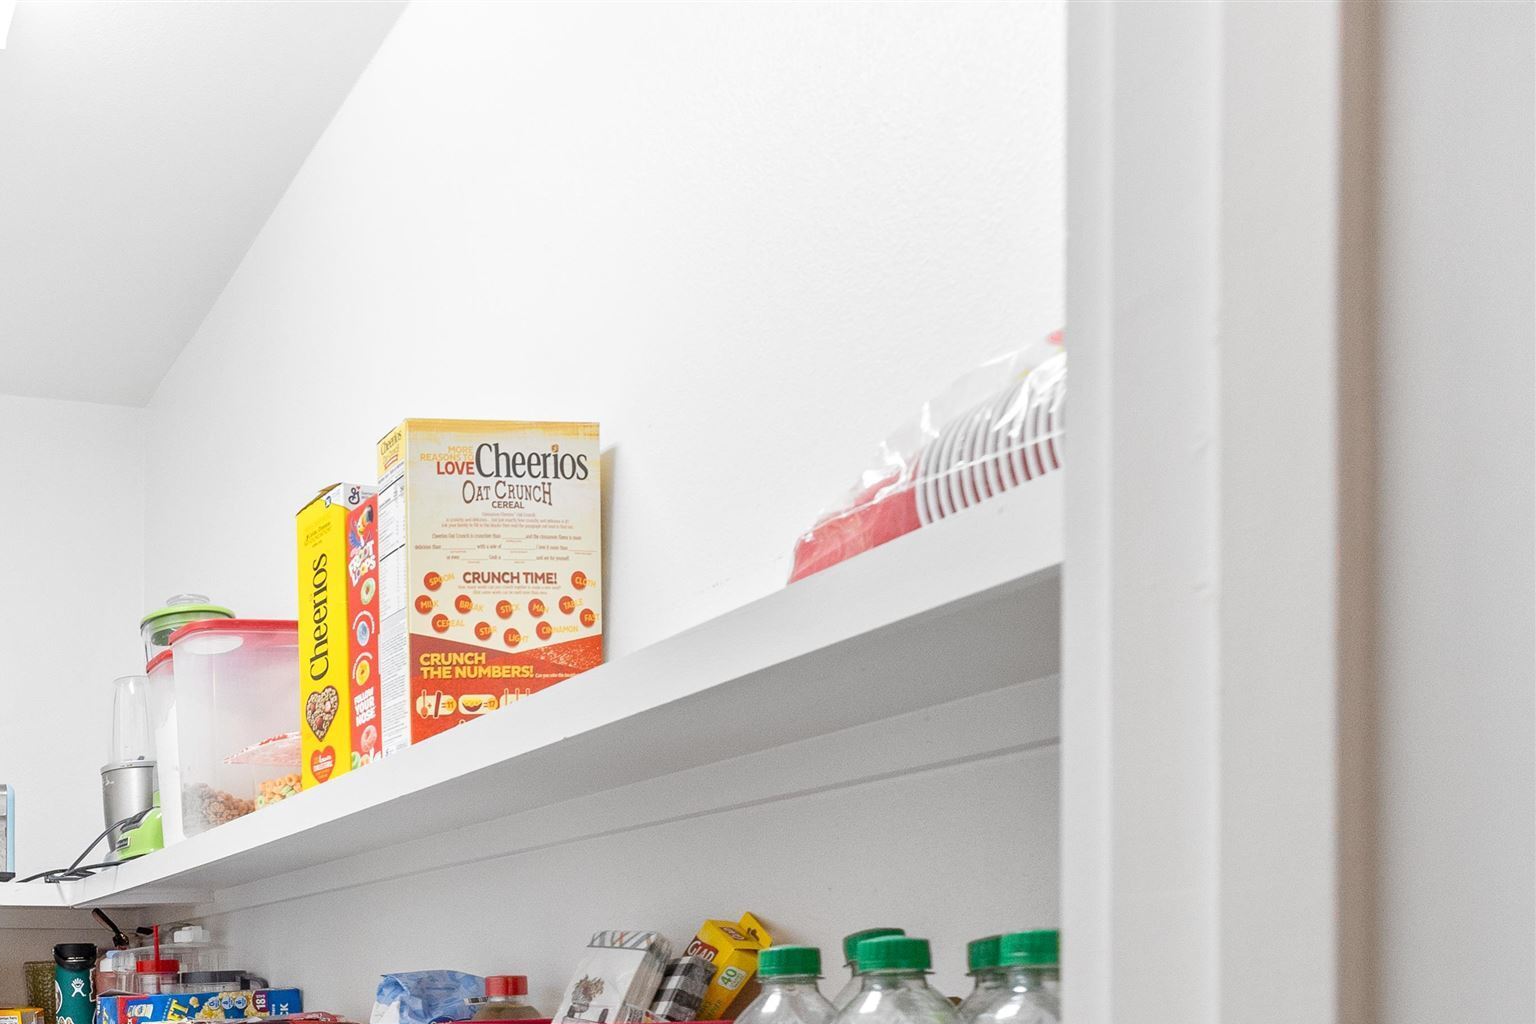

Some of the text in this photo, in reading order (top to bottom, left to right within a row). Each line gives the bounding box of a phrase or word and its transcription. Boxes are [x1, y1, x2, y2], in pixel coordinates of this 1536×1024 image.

[436, 461, 475, 475] LOVE
[475, 443, 590, 481] Cheerios
[462, 480, 553, 506] OAT CRUNCH
[491, 501, 525, 509] CEREAL
[429, 573, 455, 586] SPOON
[463, 572, 557, 584] CRUNCH TIME!
[575, 576, 596, 587] CLOTH
[420, 601, 439, 609] MILK
[459, 601, 484, 612] BREAK
[532, 604, 549, 613] MAN
[310, 553, 329, 681] Cheerios
[437, 619, 464, 628] CEREAL
[479, 627, 497, 636] STAR
[541, 625, 578, 635] CINNAMON
[508, 634, 529, 643] LIGHT
[419, 652, 486, 666] CRUNCH
[420, 665, 535, 679] THE NUMBERS!
[687, 941, 715, 963] GLAD
[720, 968, 738, 986] 40
